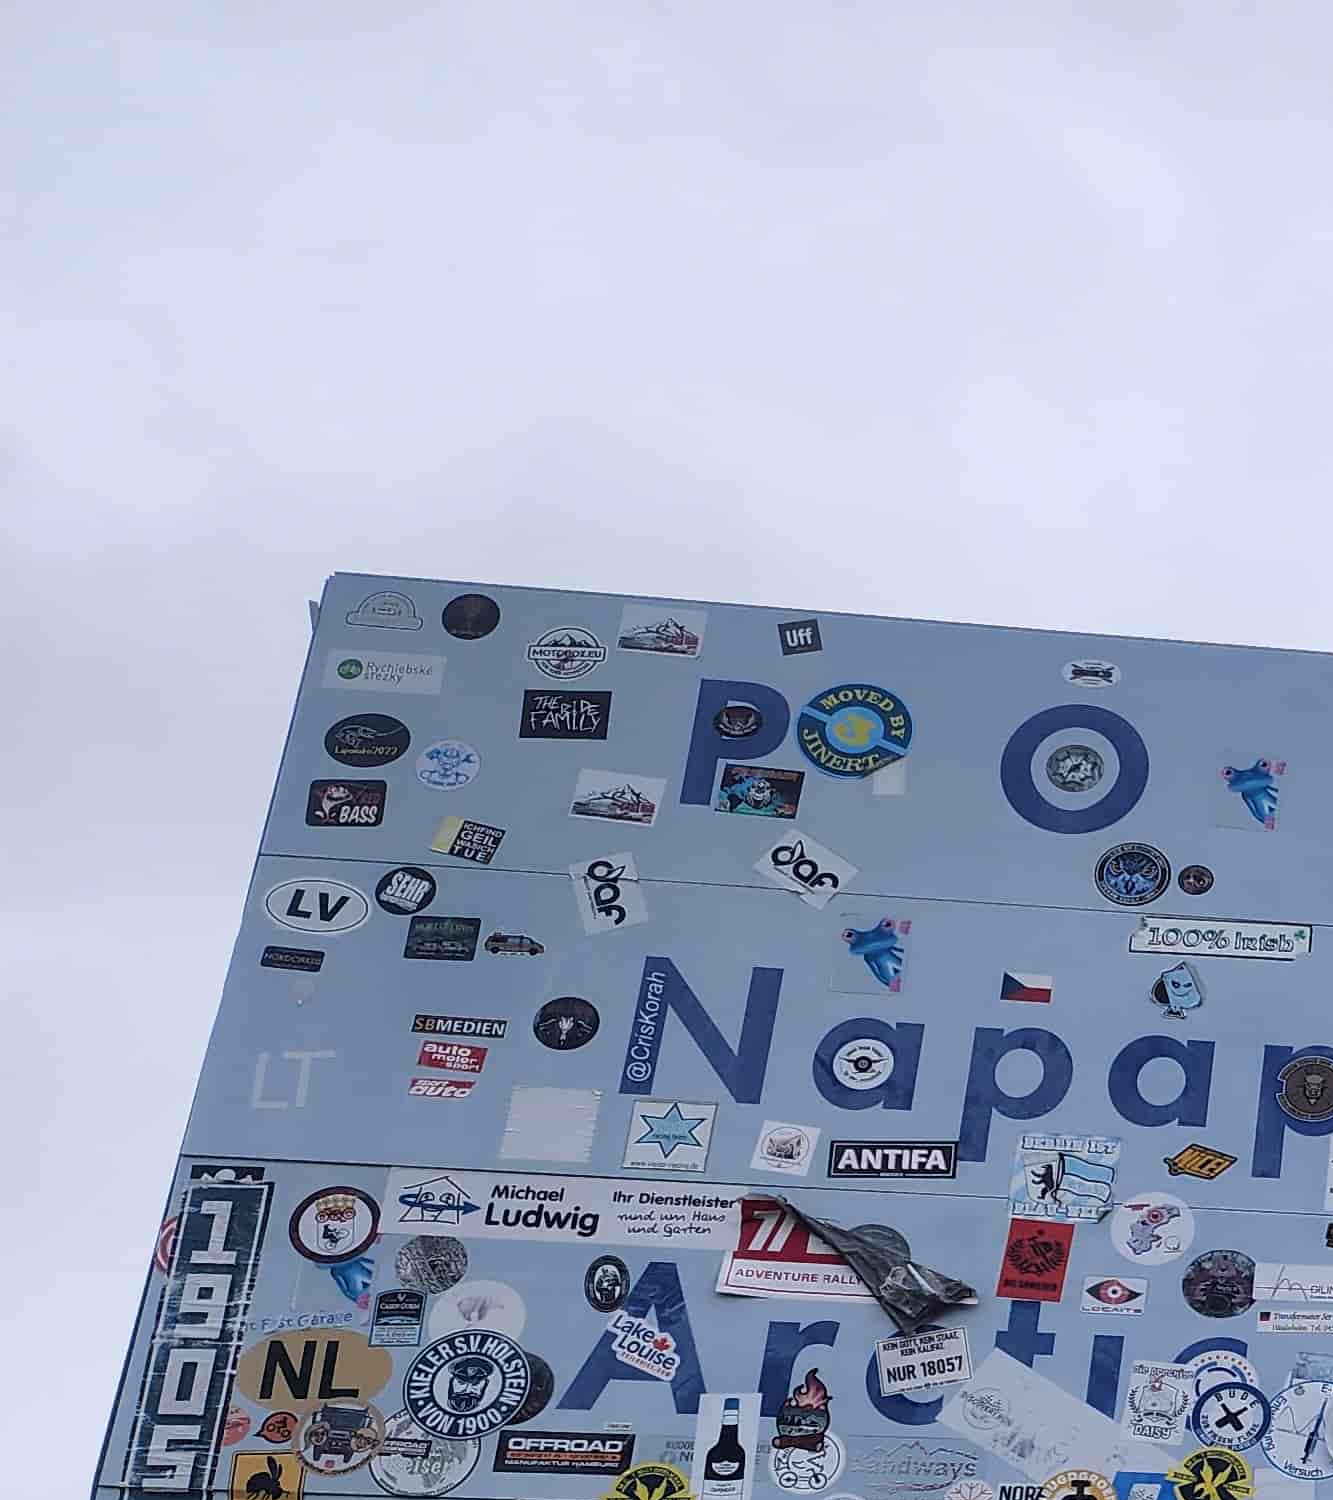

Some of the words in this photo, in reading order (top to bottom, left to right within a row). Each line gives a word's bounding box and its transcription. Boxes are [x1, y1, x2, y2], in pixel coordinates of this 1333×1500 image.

[786, 628, 813, 647] Uff
[287, 889, 350, 922] LV
[1148, 926, 1229, 949] 100%
[1234, 932, 1294, 952] Irish
[414, 1016, 505, 1035] SBMEDIEN
[628, 971, 665, 1084] @CrisKorah
[838, 1149, 948, 1172] ANTIFA
[492, 1185, 564, 1202] Michael
[612, 1192, 634, 1204] Ihr
[639, 1194, 735, 1208] Dienstleister
[485, 1204, 599, 1236] Ludwig
[735, 1268, 818, 1282] ADVENTURE
[614, 1315, 655, 1338] Lake
[615, 1335, 674, 1368] Louise
[259, 1340, 360, 1400] NL
[886, 1364, 918, 1381] NUR
[921, 1356, 964, 1376] 18057
[506, 1438, 622, 1454] OFFROAD
